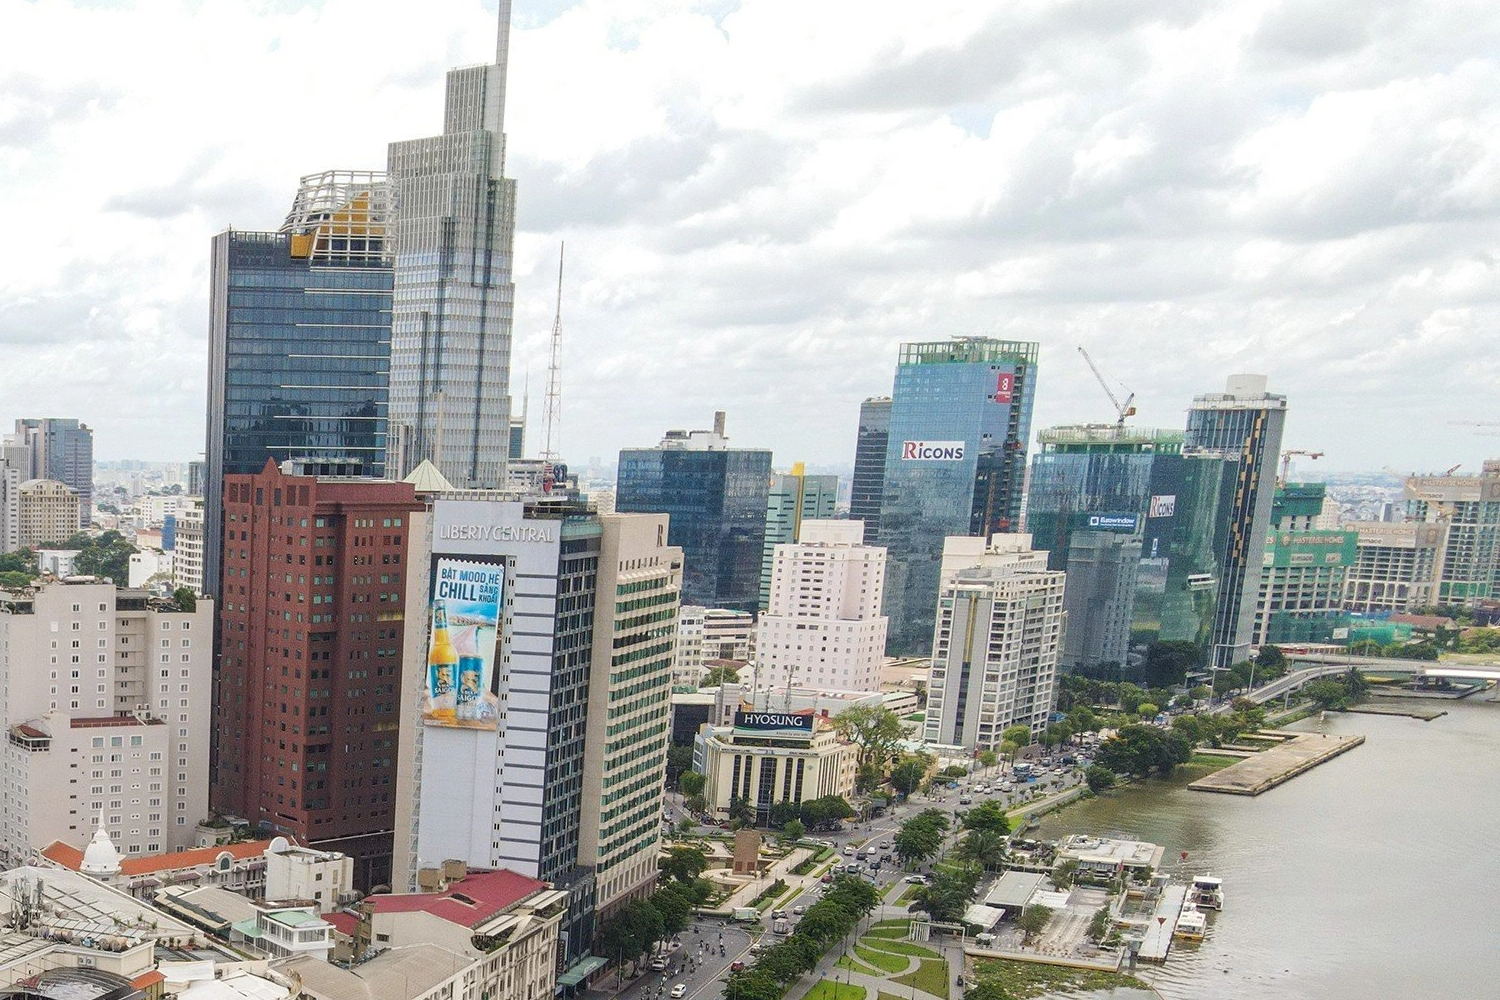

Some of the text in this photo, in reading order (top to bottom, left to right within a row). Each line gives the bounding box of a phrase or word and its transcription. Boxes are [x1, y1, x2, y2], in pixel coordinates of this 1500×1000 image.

[440, 524, 554, 543] LIBERTY CENTRAL
[459, 570, 486, 583] MOOD
[439, 581, 477, 602] CHILL
[744, 713, 803, 727] HYOSUNG
